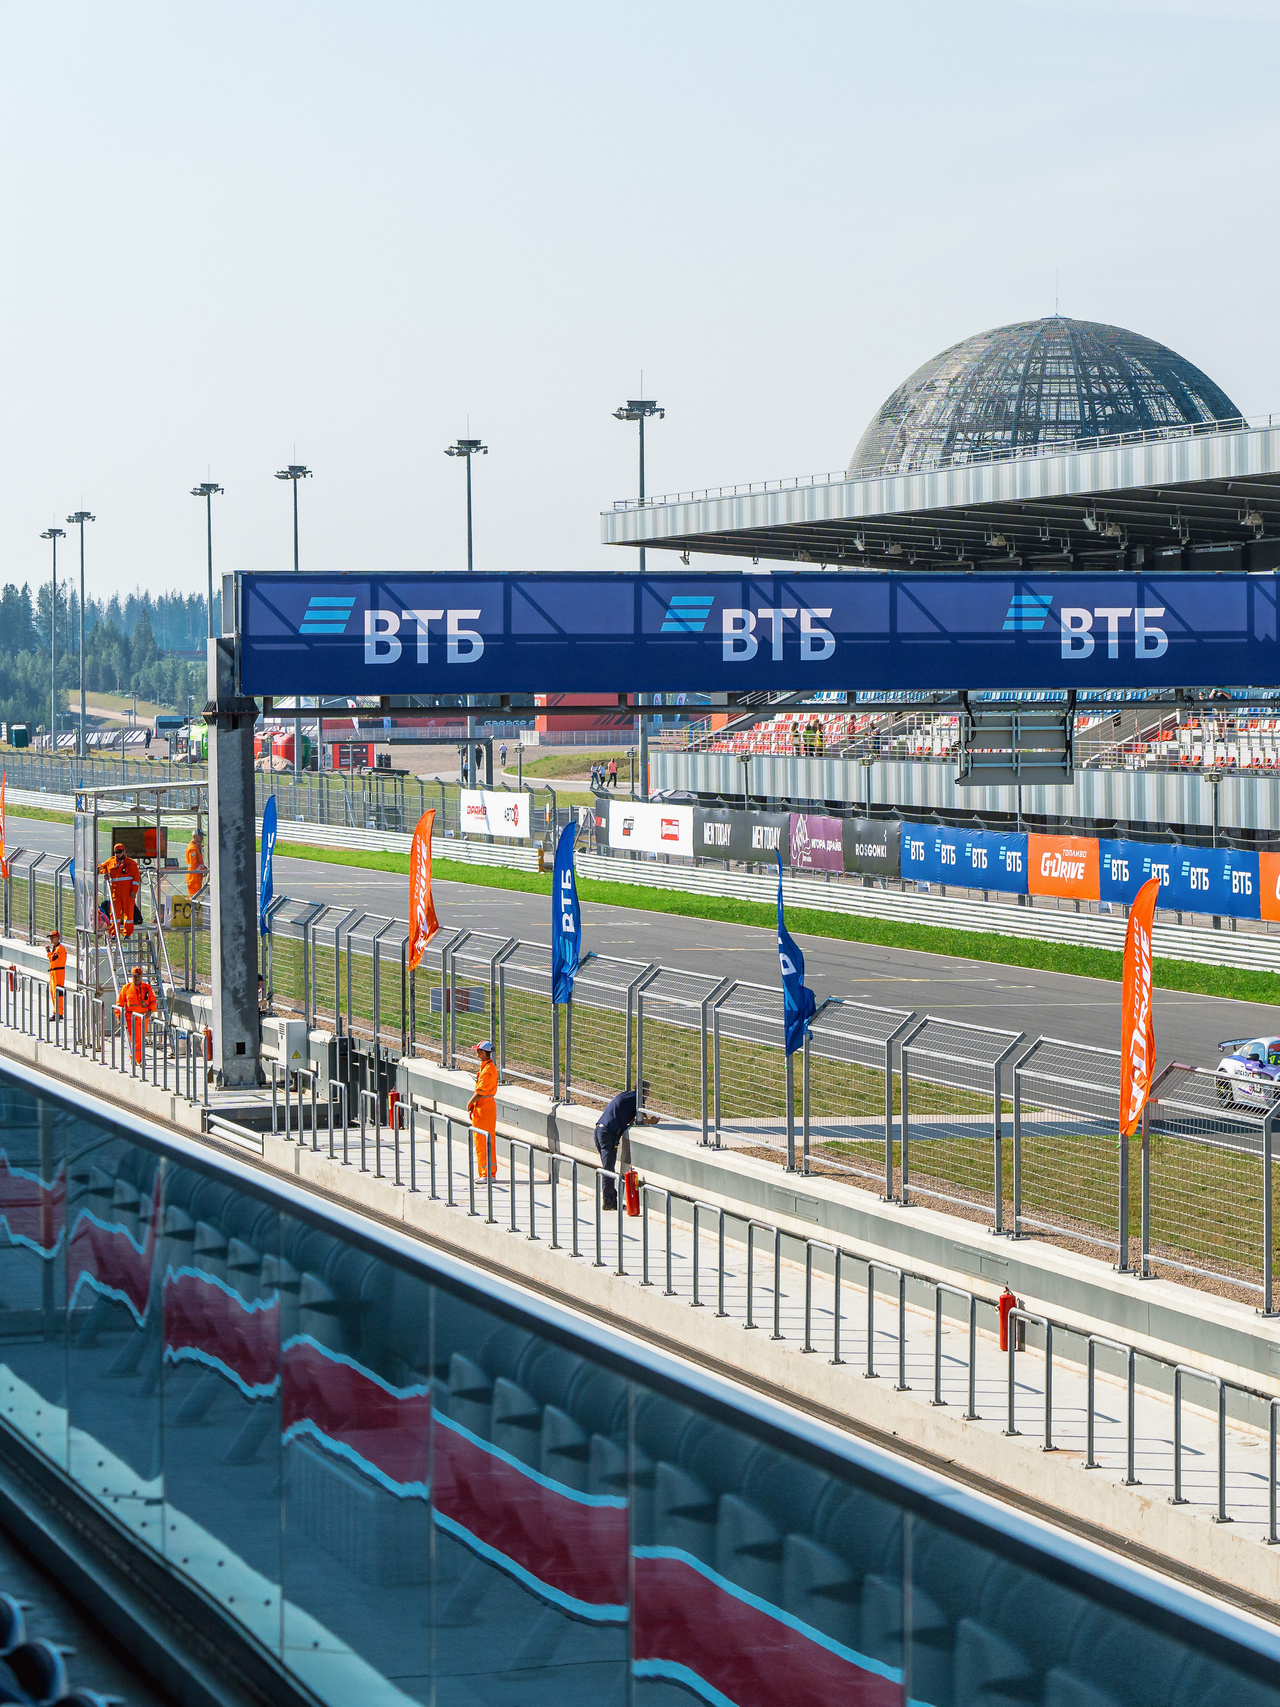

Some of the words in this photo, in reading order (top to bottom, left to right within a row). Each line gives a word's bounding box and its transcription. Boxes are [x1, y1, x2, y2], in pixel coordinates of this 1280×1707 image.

[365, 610, 484, 663] ВТБ
[723, 608, 835, 660] ВТБ
[1062, 608, 1168, 658] ВТБ
[856, 844, 886, 857] ROSGONKI
[910, 842, 924, 861] ВТБ
[941, 845, 956, 865] ВТБ
[972, 848, 987, 868] ВТБ
[1007, 851, 1022, 872] ВТБ
[1111, 860, 1129, 881] ВТБ
[1152, 864, 1169, 887] ВТБ
[1190, 868, 1209, 890] ВТБ
[1232, 871, 1252, 894] ВТБ
[561, 868, 576, 934] ВТБ
